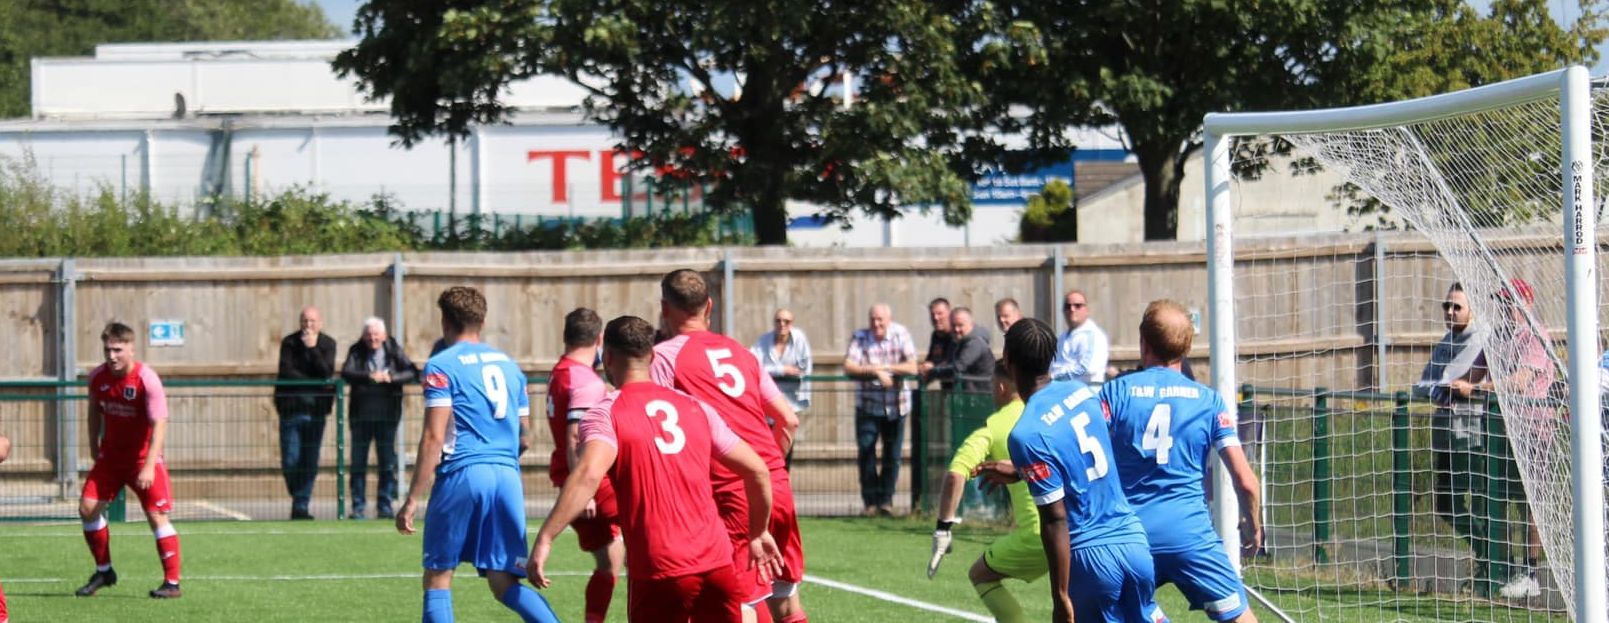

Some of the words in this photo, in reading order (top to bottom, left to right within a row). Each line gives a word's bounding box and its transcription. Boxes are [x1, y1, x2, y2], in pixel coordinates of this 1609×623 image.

[1573, 175, 1583, 202] MARK
[1575, 204, 1583, 245] HARROD
[482, 364, 508, 419] 9
[706, 348, 746, 398] 5
[645, 400, 686, 454] 3
[1070, 411, 1110, 482] 5
[1142, 403, 1173, 464] 4
